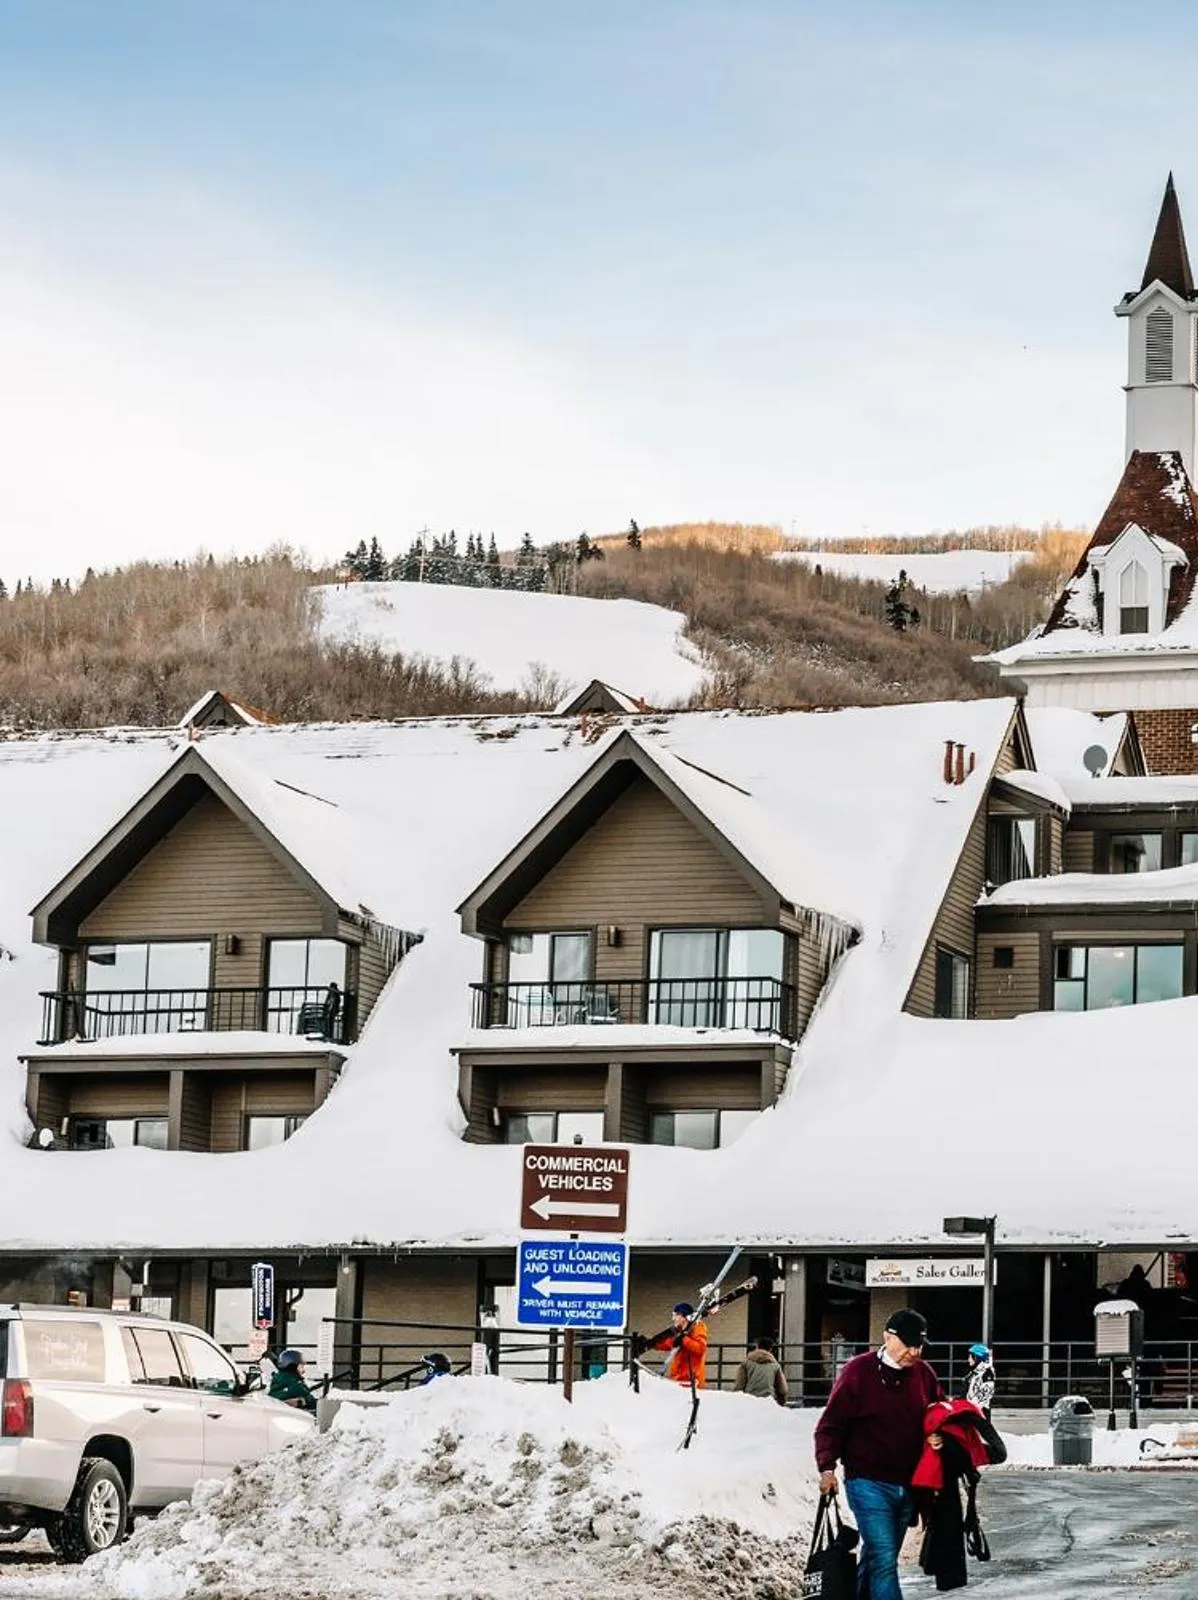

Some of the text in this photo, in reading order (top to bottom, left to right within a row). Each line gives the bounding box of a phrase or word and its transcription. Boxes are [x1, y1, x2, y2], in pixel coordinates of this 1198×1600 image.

[525, 1155, 627, 1173] COMMERCIAL
[538, 1174, 613, 1191] VEHICLES
[525, 1249, 620, 1262] GUEST LOADING
[524, 1262, 621, 1276] AND UNLOADING
[916, 1264, 946, 1278] Sales
[949, 1264, 987, 1278] Galler
[522, 1299, 620, 1310] DRIVER MUST REMAIN
[540, 1309, 602, 1319] WITH VEHICLE
